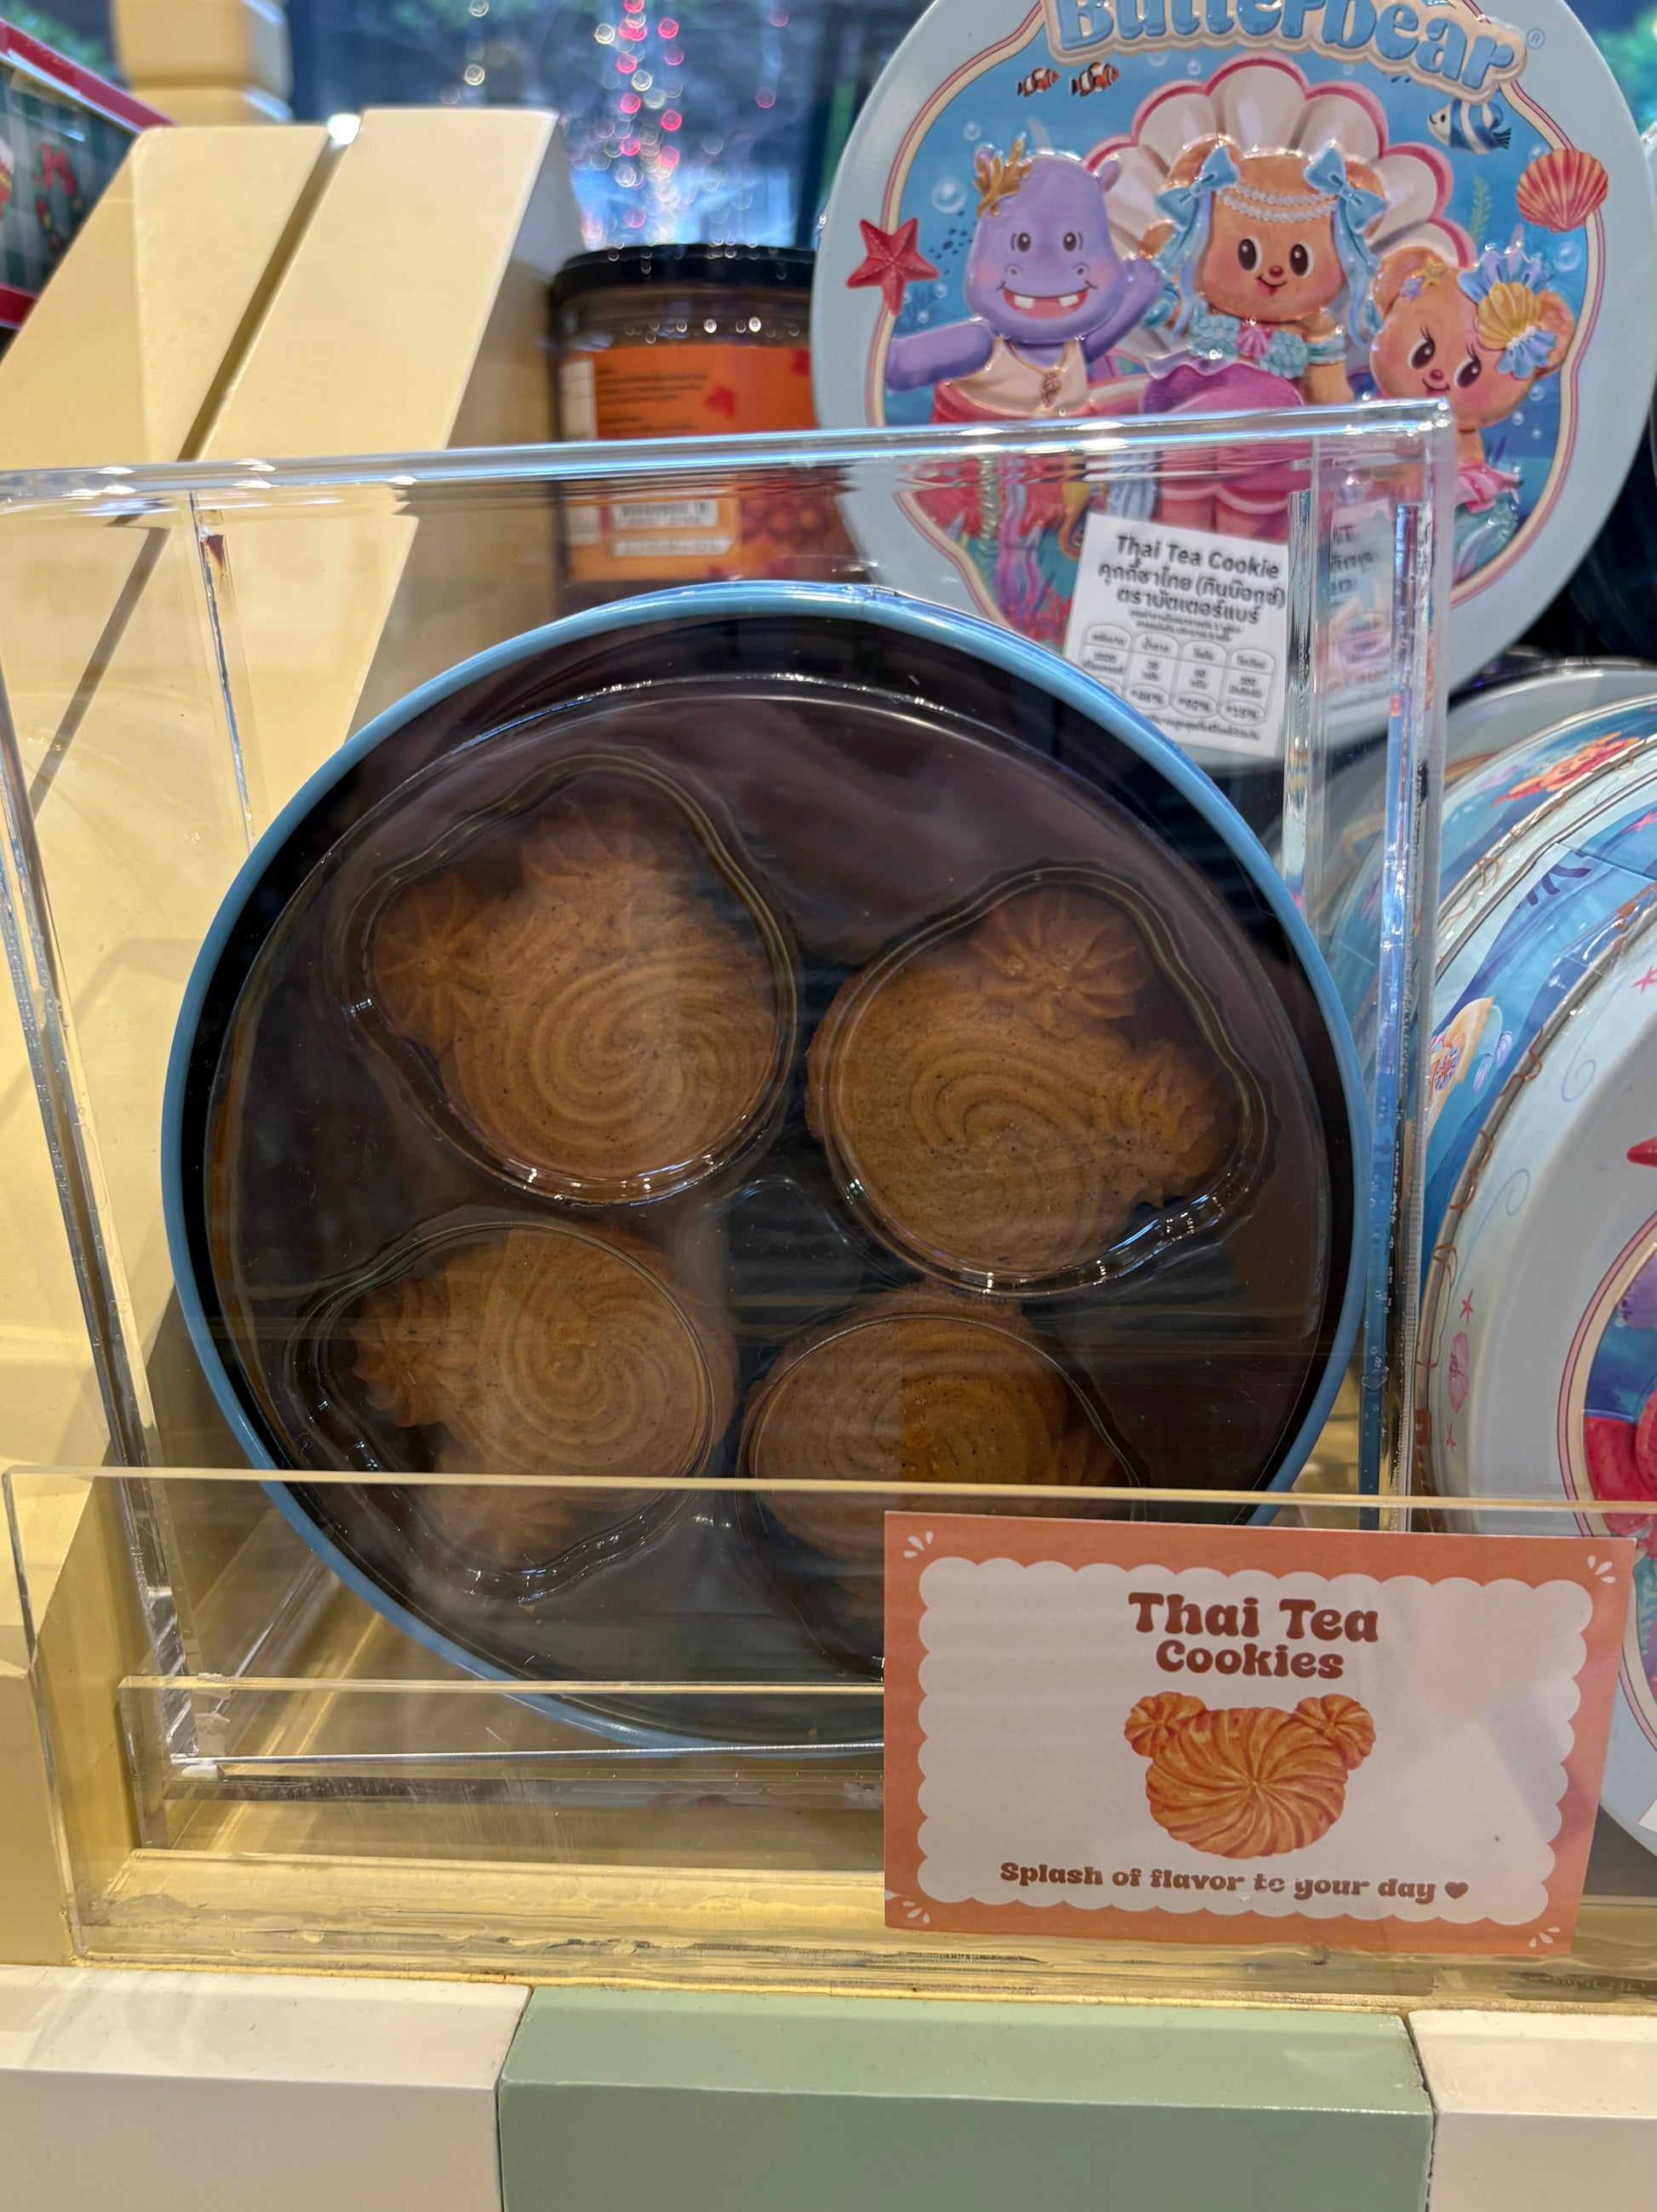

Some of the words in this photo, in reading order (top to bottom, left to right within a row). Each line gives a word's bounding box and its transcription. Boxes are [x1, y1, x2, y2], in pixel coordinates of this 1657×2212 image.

[1116, 535, 1161, 560] Thai
[1167, 544, 1201, 565] Tea
[1208, 552, 1280, 580] Cookie
[1128, 1591, 1260, 1637] Thai
[1279, 1598, 1379, 1643] Tea
[1156, 1639, 1345, 1679] Cookies
[1001, 1862, 1104, 1887] Splash
[1112, 1869, 1143, 1887] of
[1150, 1869, 1246, 1890] flavor
[1294, 1876, 1371, 1900] your
[1378, 1878, 1436, 1905] day
